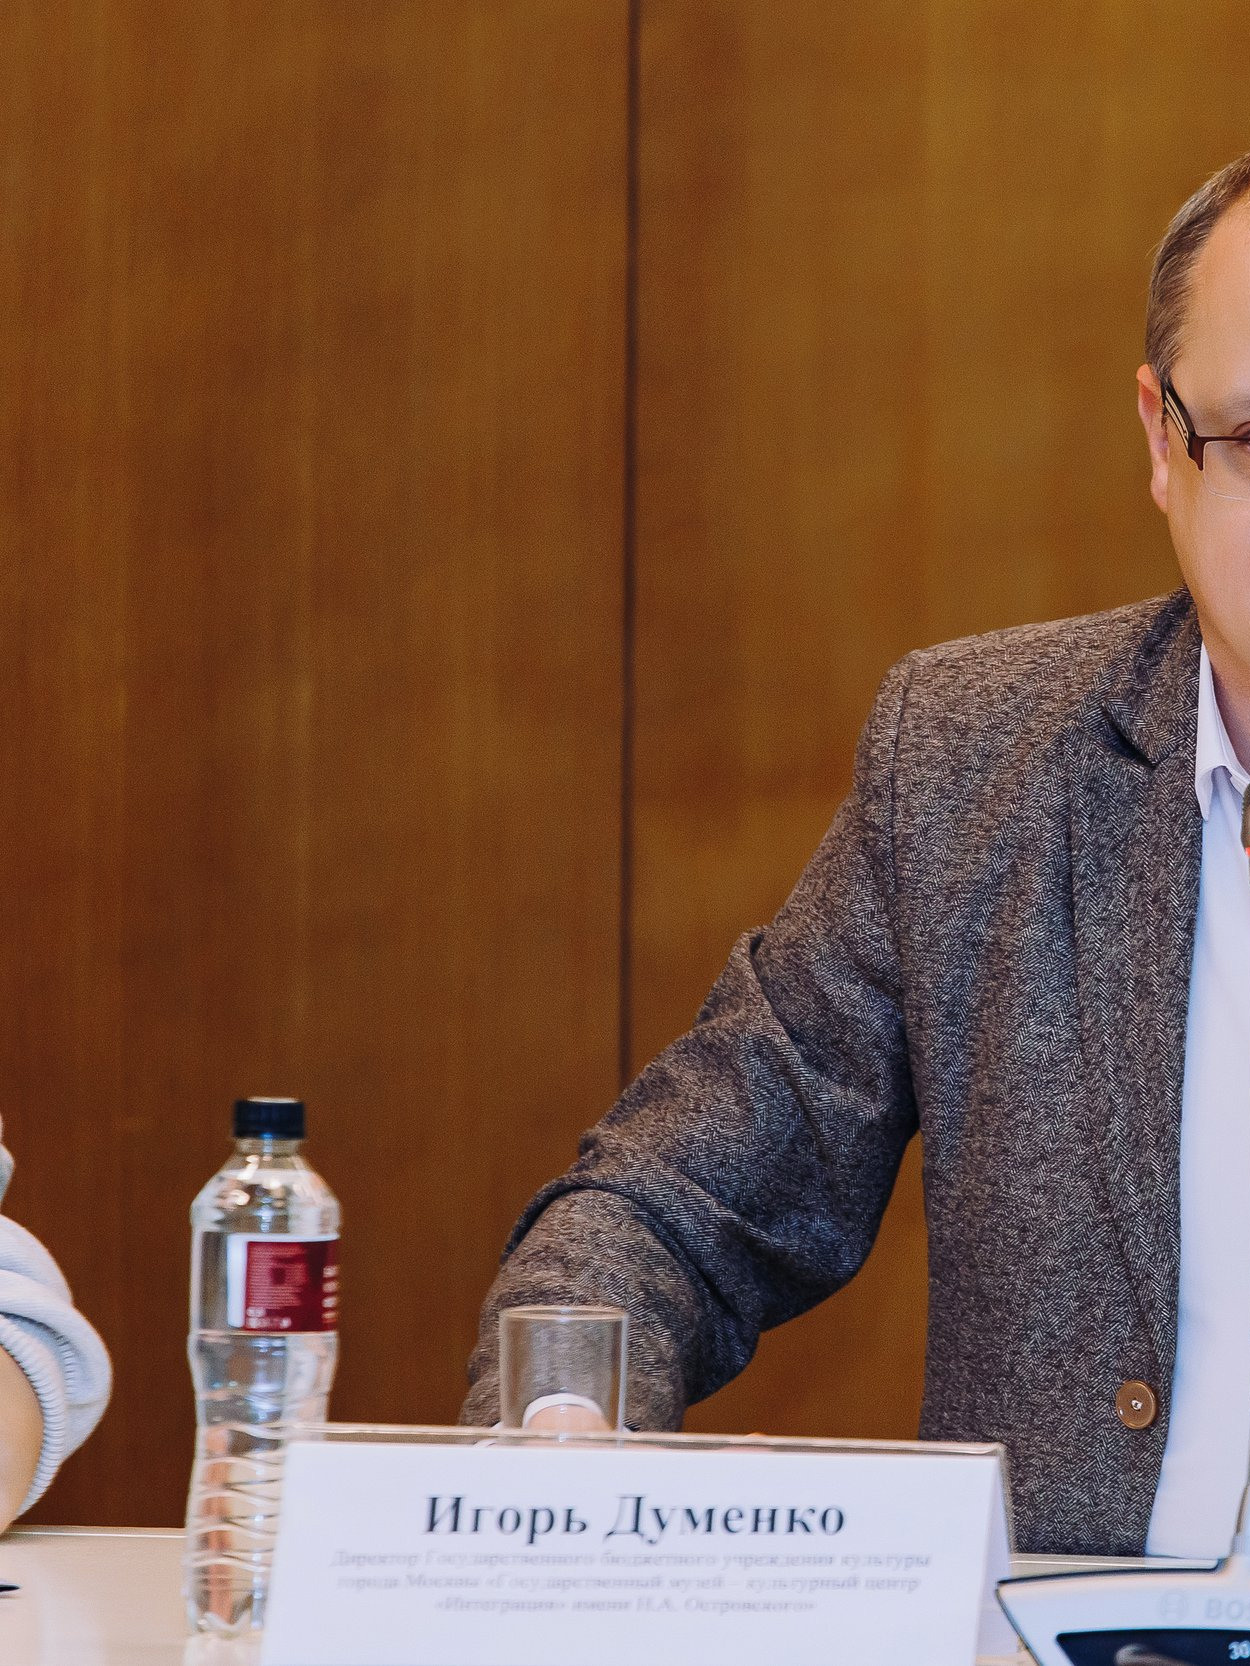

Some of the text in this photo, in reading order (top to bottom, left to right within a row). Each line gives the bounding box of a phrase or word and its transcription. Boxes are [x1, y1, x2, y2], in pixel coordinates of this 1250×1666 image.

[422, 1493, 846, 1546] Игорь Думенко
[328, 1549, 418, 1568] Директор
[841, 1554, 932, 1570] культуры
[865, 1577, 921, 1594] центр
